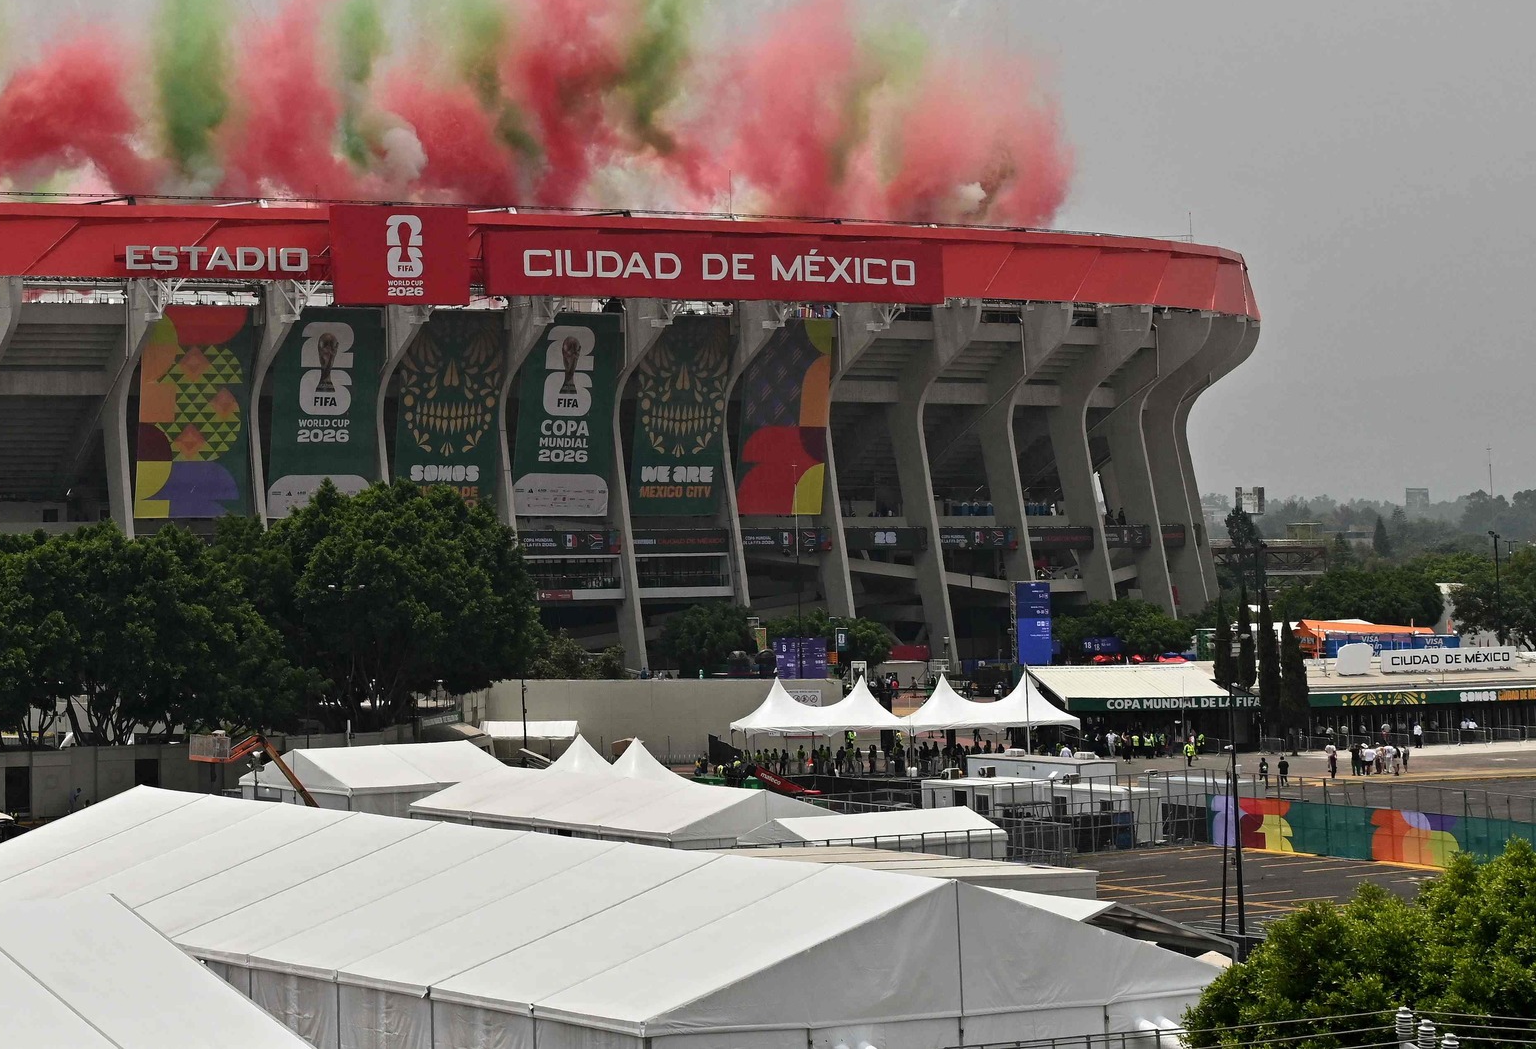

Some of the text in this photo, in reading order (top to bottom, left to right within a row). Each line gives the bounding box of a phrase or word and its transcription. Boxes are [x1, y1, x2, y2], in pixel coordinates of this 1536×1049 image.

[125, 245, 309, 272] ESTADIO
[523, 249, 915, 286] CIUDAD DE MÉXICO
[387, 287, 424, 296] 2026
[313, 396, 337, 407] FIFA
[557, 398, 579, 408] FIFA
[298, 418, 350, 428] WORLD CUP
[541, 419, 590, 436] COPA
[297, 429, 350, 443] 2026
[539, 437, 589, 449] MUNDIAL
[538, 449, 588, 463] 2026
[410, 465, 480, 482] SOMOS
[641, 465, 670, 483] WE
[639, 485, 712, 499] MEXICO CITY
[1084, 641, 1092, 649] 18
[1361, 635, 1379, 643] VISA
[1391, 650, 1510, 666] CIUDAD DE MÉXICO
[1107, 696, 1261, 710] COPA MUNDIAL DE LA FIFA
[1460, 690, 1497, 703] SOMOS
[760, 771, 781, 786] mateco
